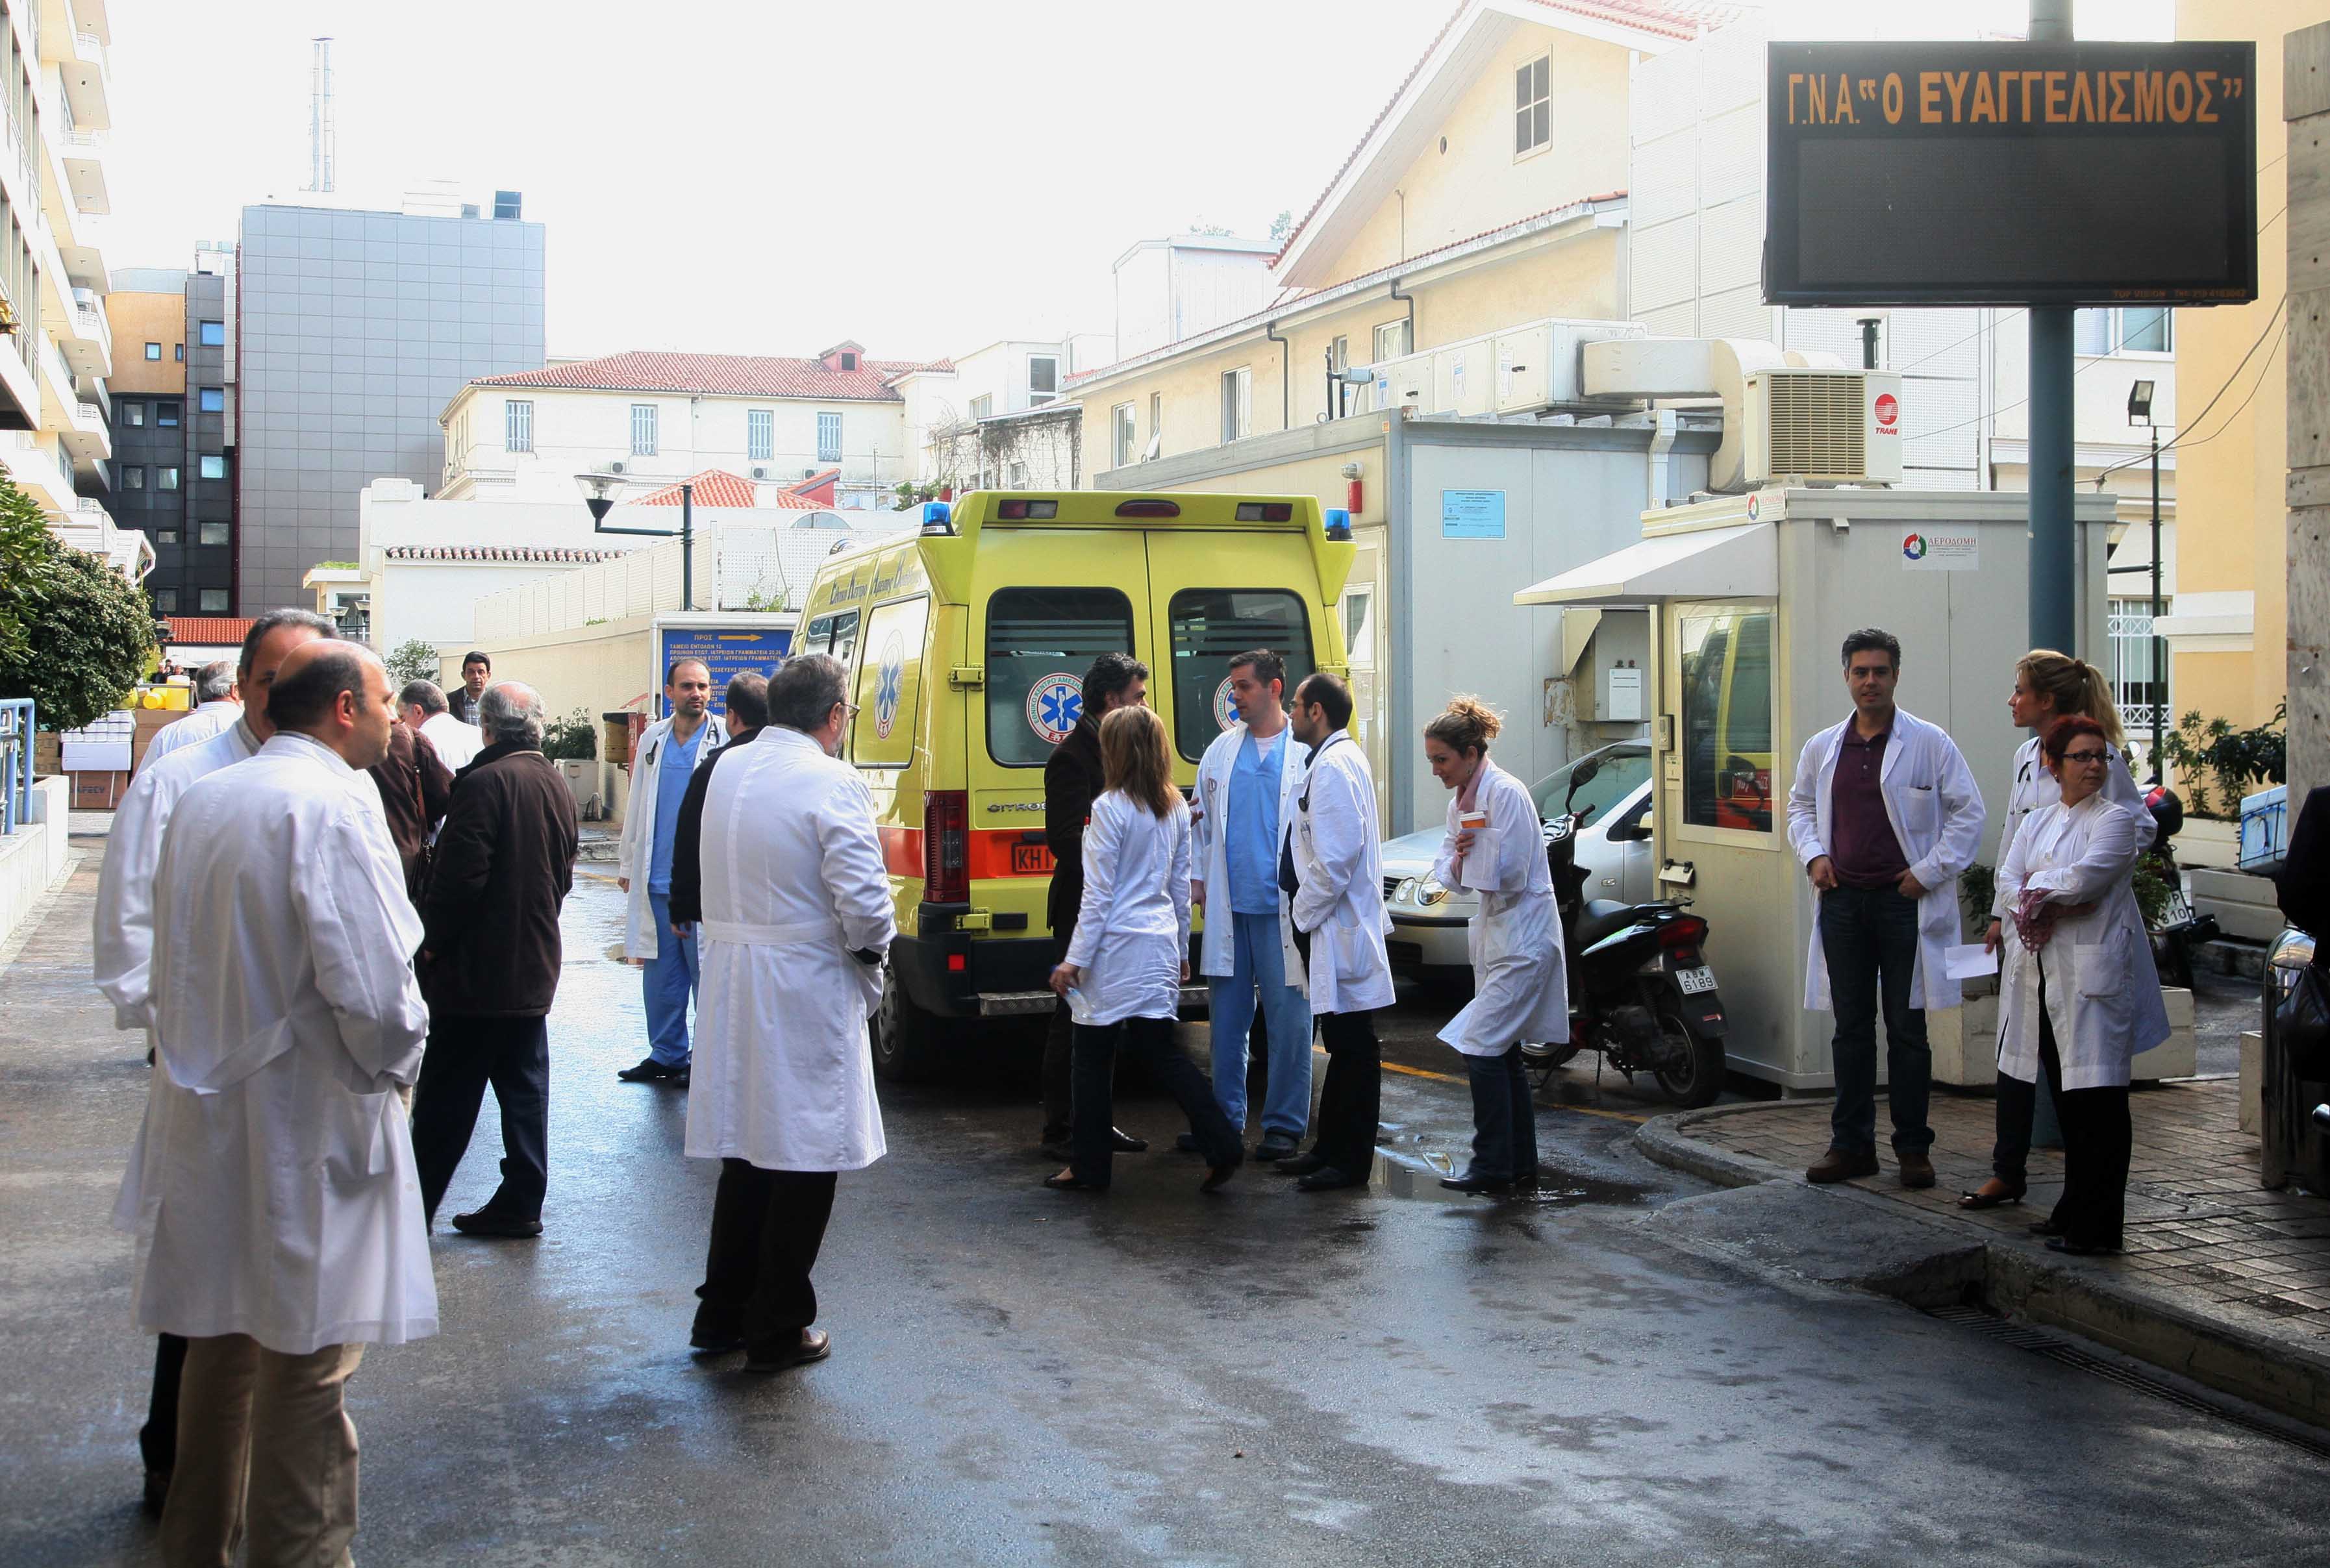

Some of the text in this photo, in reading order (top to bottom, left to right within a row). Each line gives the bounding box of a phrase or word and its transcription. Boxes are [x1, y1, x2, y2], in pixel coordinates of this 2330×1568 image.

[1928, 537, 1976, 545] ΑΕΡΟΔΟΜΗ
[1034, 677, 1057, 697] ΚΕΝΤΡΟ
[987, 803, 1046, 813] CITRO
[1684, 977, 1714, 990] 6189
